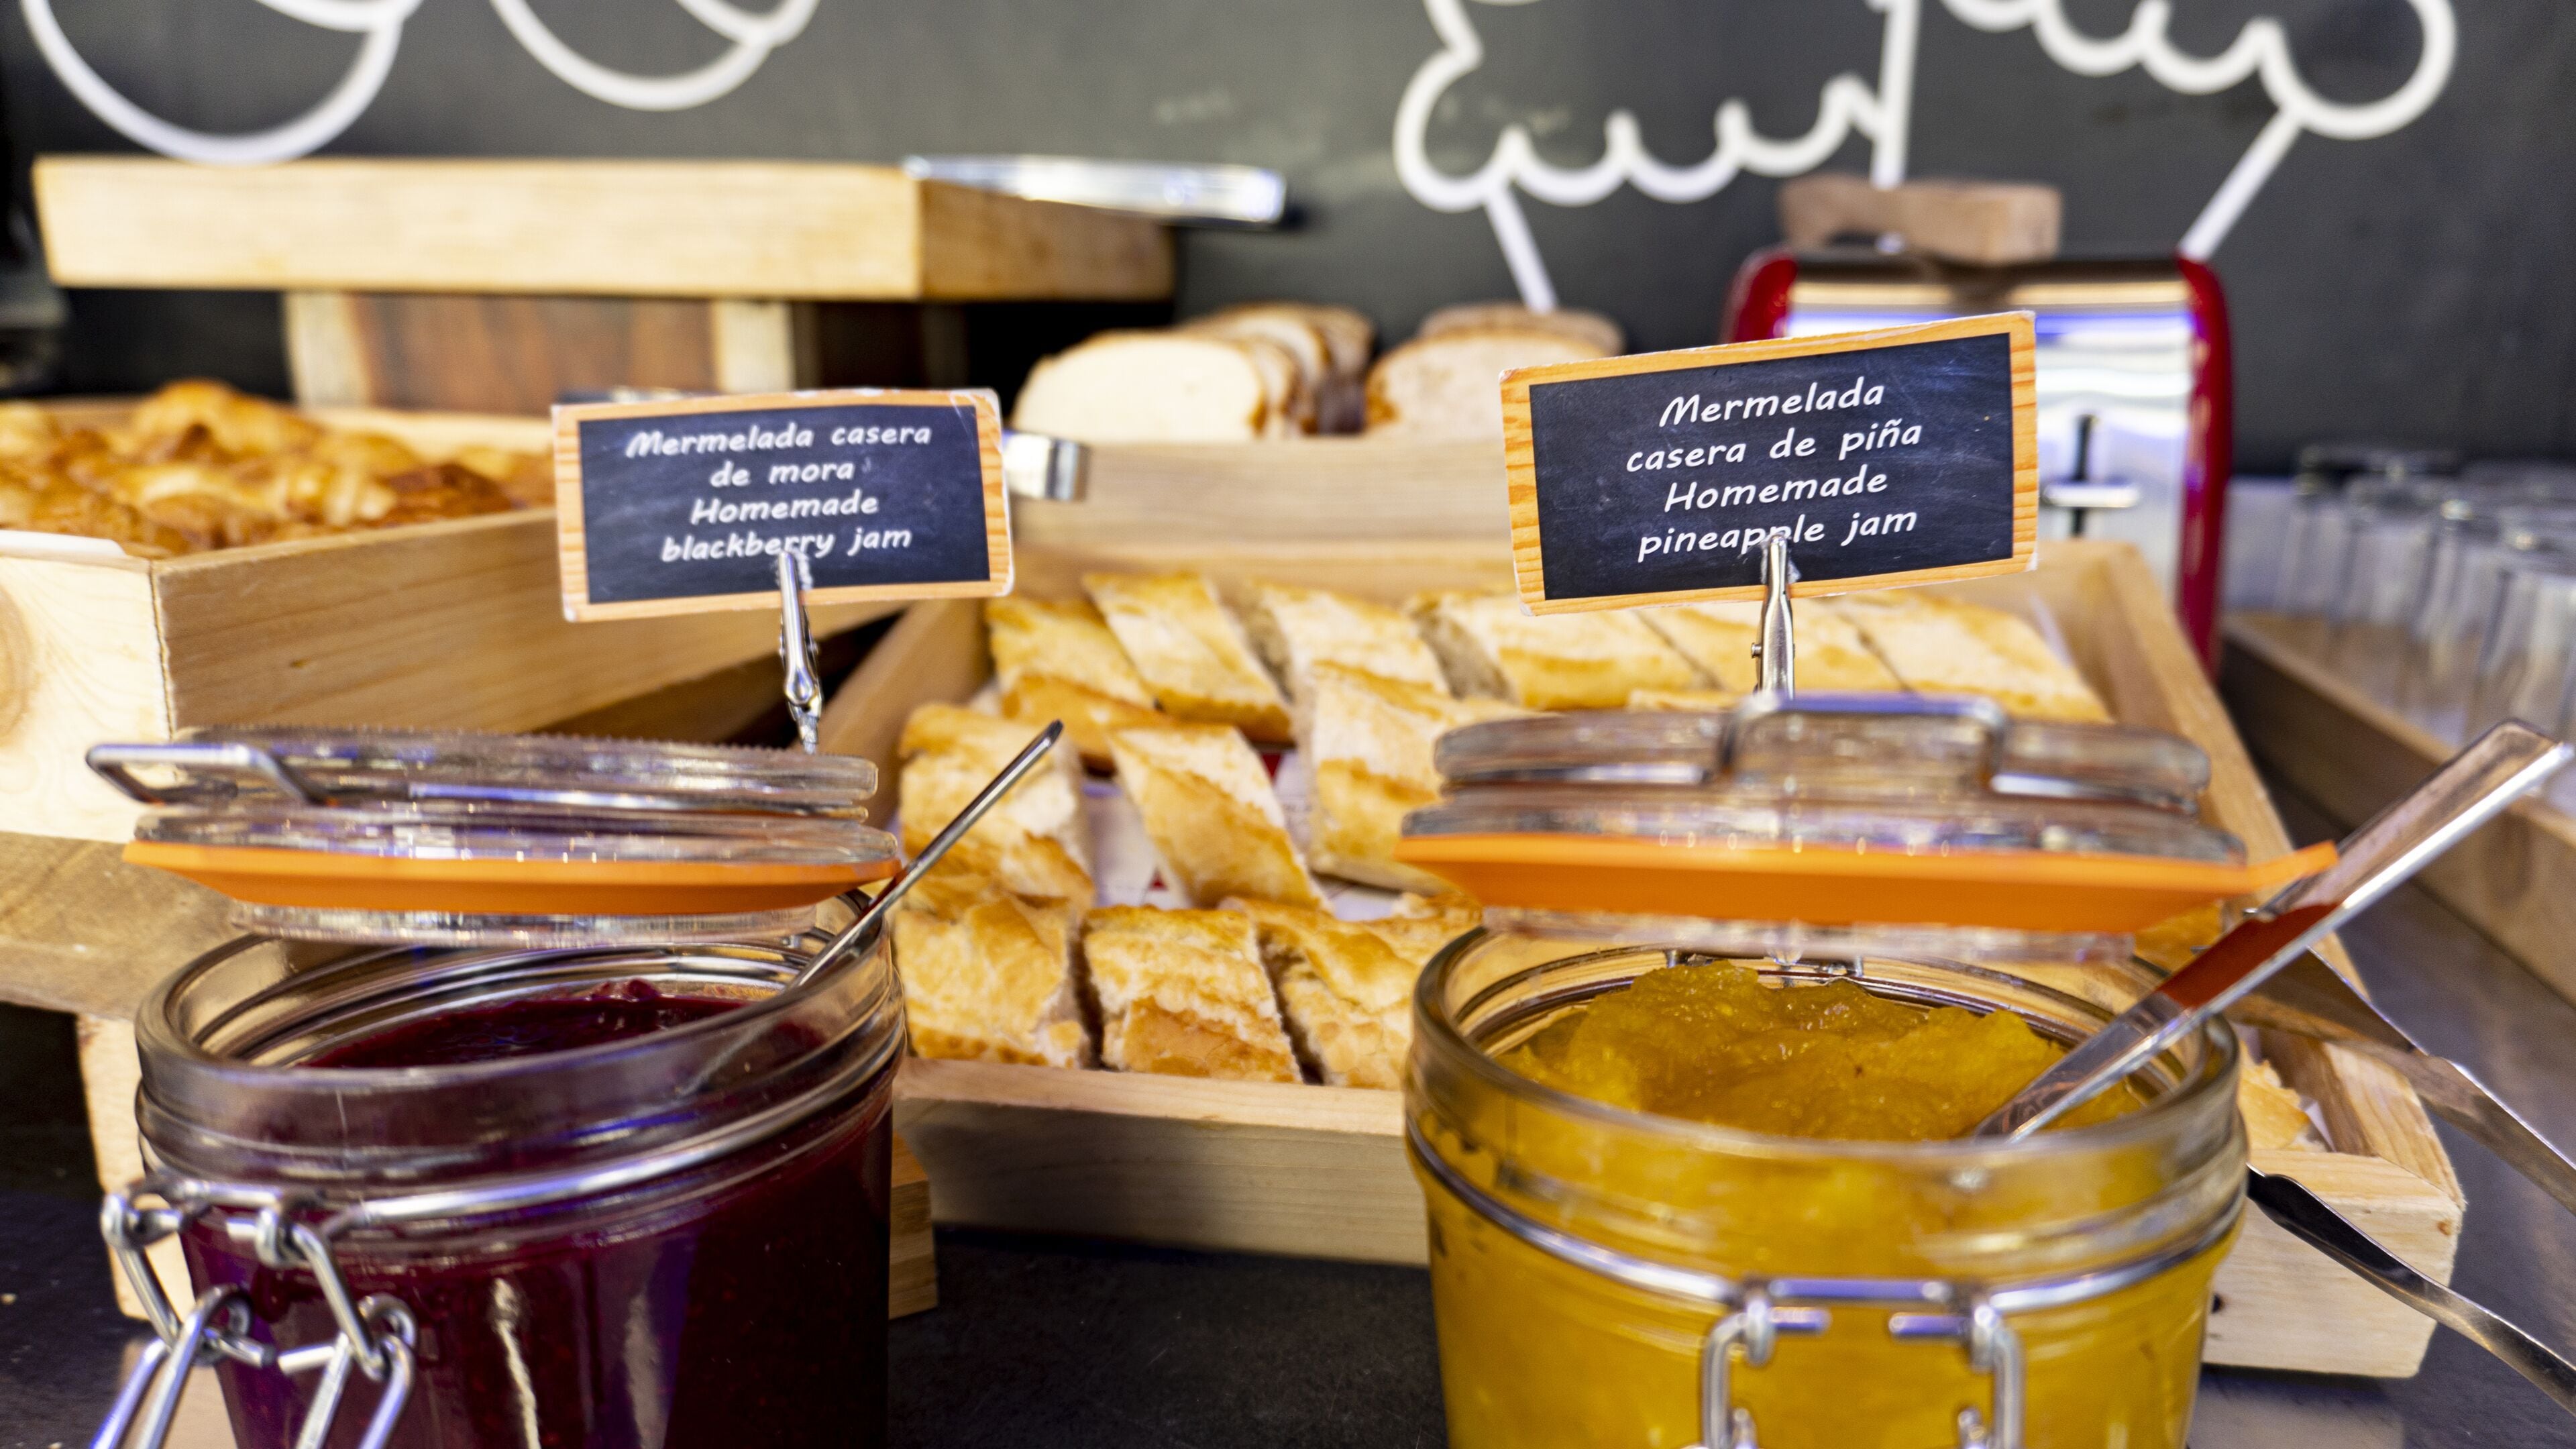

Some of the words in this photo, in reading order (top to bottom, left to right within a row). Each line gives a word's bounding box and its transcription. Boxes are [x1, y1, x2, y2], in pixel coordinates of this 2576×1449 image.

[1659, 376, 1884, 428] Mermelada
[625, 422, 814, 458] Mermelada
[831, 427, 930, 445] casera
[1627, 443, 1746, 472] casera
[1770, 427, 1815, 458] de
[1839, 419, 1921, 460] piña
[710, 460, 750, 487] de
[769, 463, 855, 484] mora
[1664, 463, 1887, 512] Homemade
[690, 488, 877, 525] Homemade
[661, 531, 835, 563] blackberry
[847, 527, 911, 556] jam
[1841, 512, 1917, 546] jam
